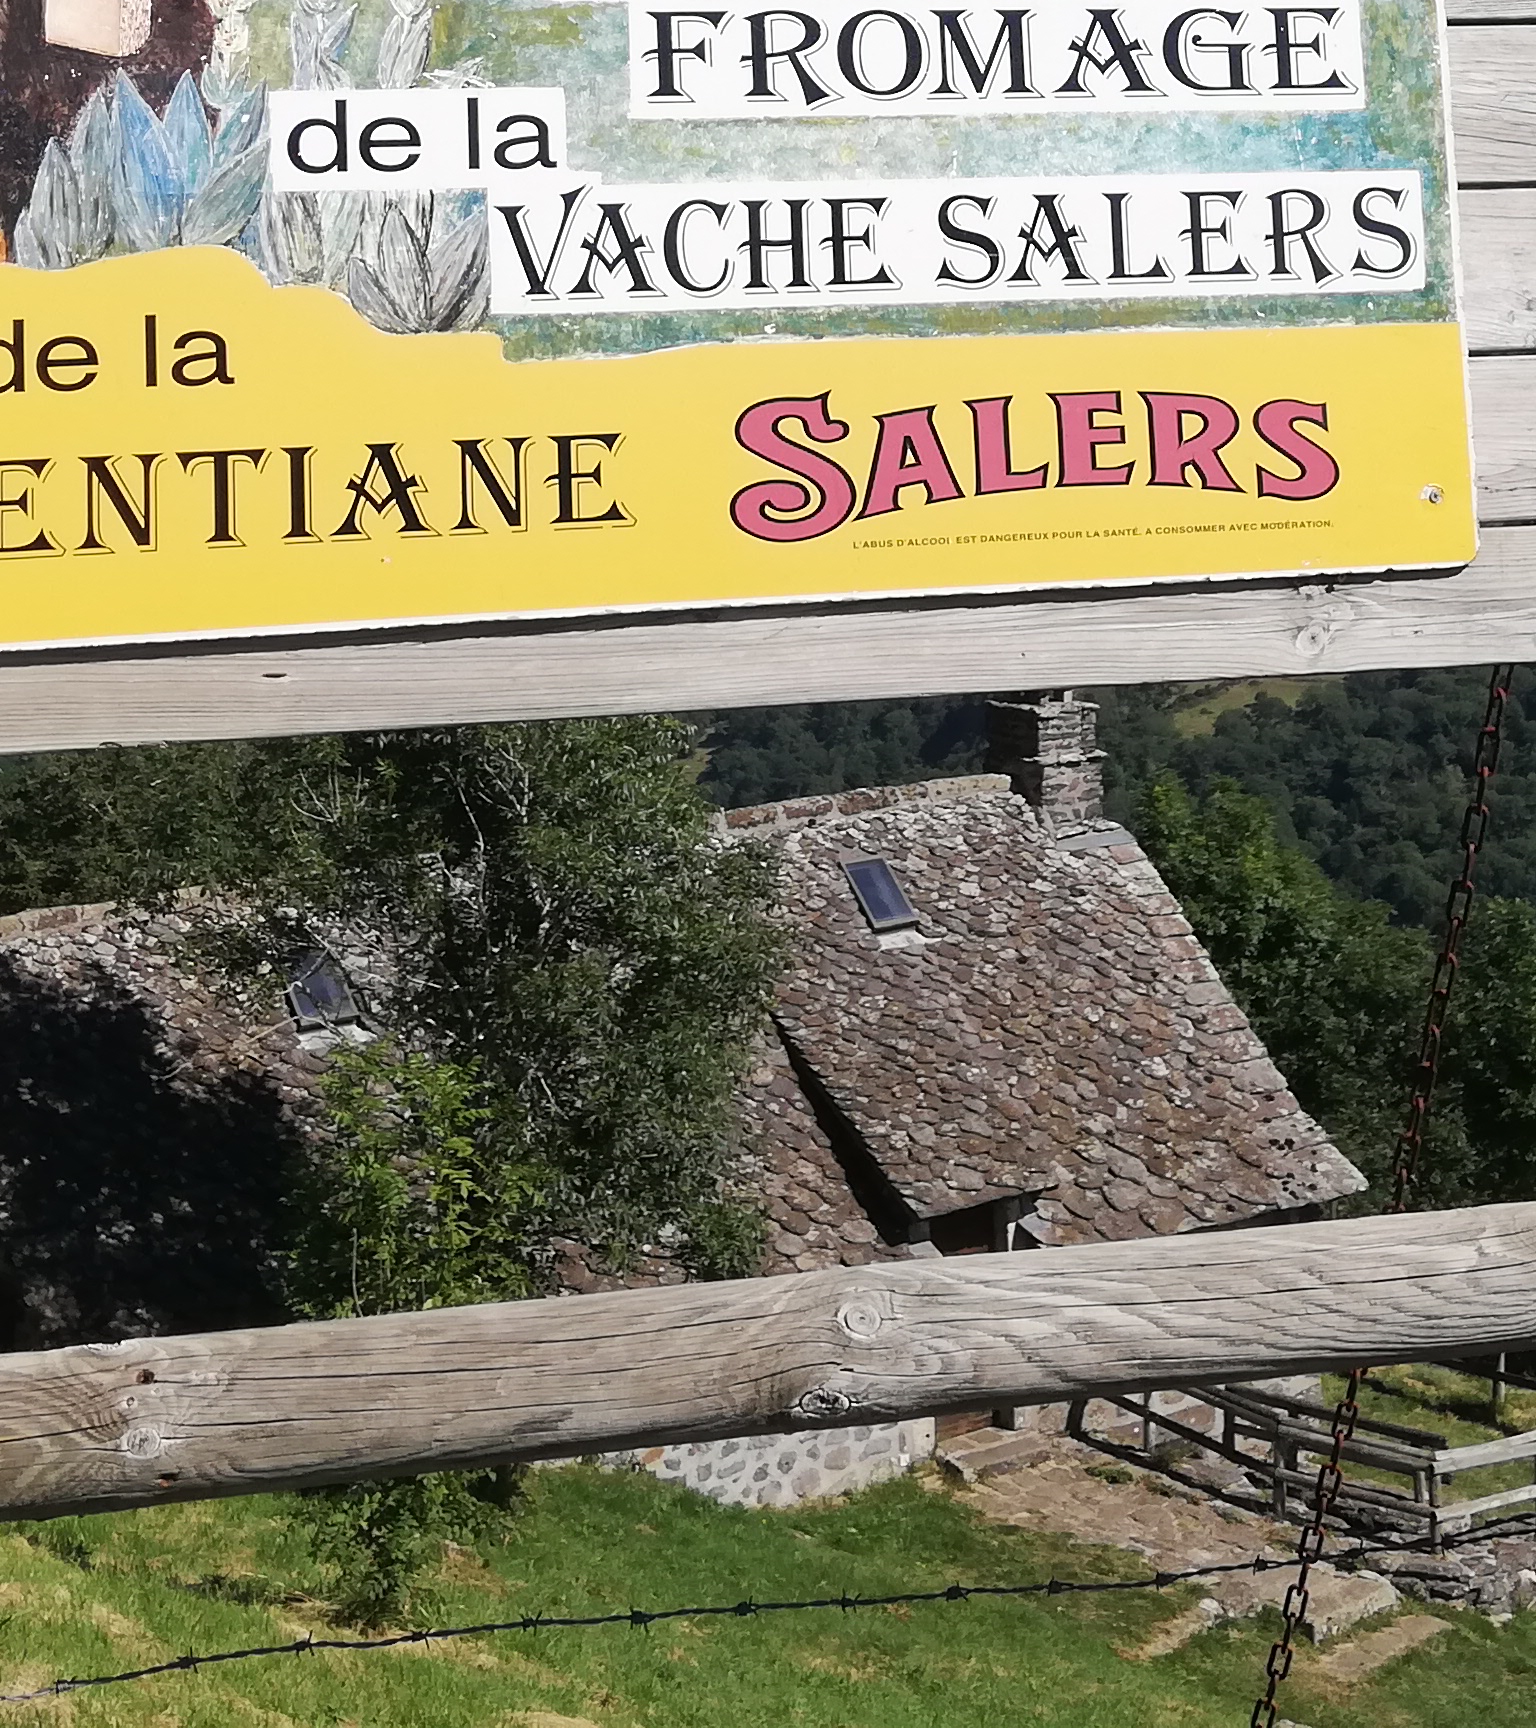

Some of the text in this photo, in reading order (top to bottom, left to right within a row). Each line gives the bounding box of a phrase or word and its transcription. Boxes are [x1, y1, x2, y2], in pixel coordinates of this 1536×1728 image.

[641, 6, 1357, 112] FROMAGE
[287, 97, 558, 174] de la
[495, 184, 1419, 300] VACHE SALERS
[144, 314, 235, 387] la
[729, 390, 1340, 543] SALERS
[853, 539, 893, 549] L'ABUS
[956, 535, 977, 544] EST
[980, 532, 1049, 543] DANGEREUX
[1052, 530, 1083, 539] POUR
[1086, 529, 1100, 538] LA
[1155, 525, 1225, 535] CONSOMMER
[1229, 522, 1257, 532] AVEC
